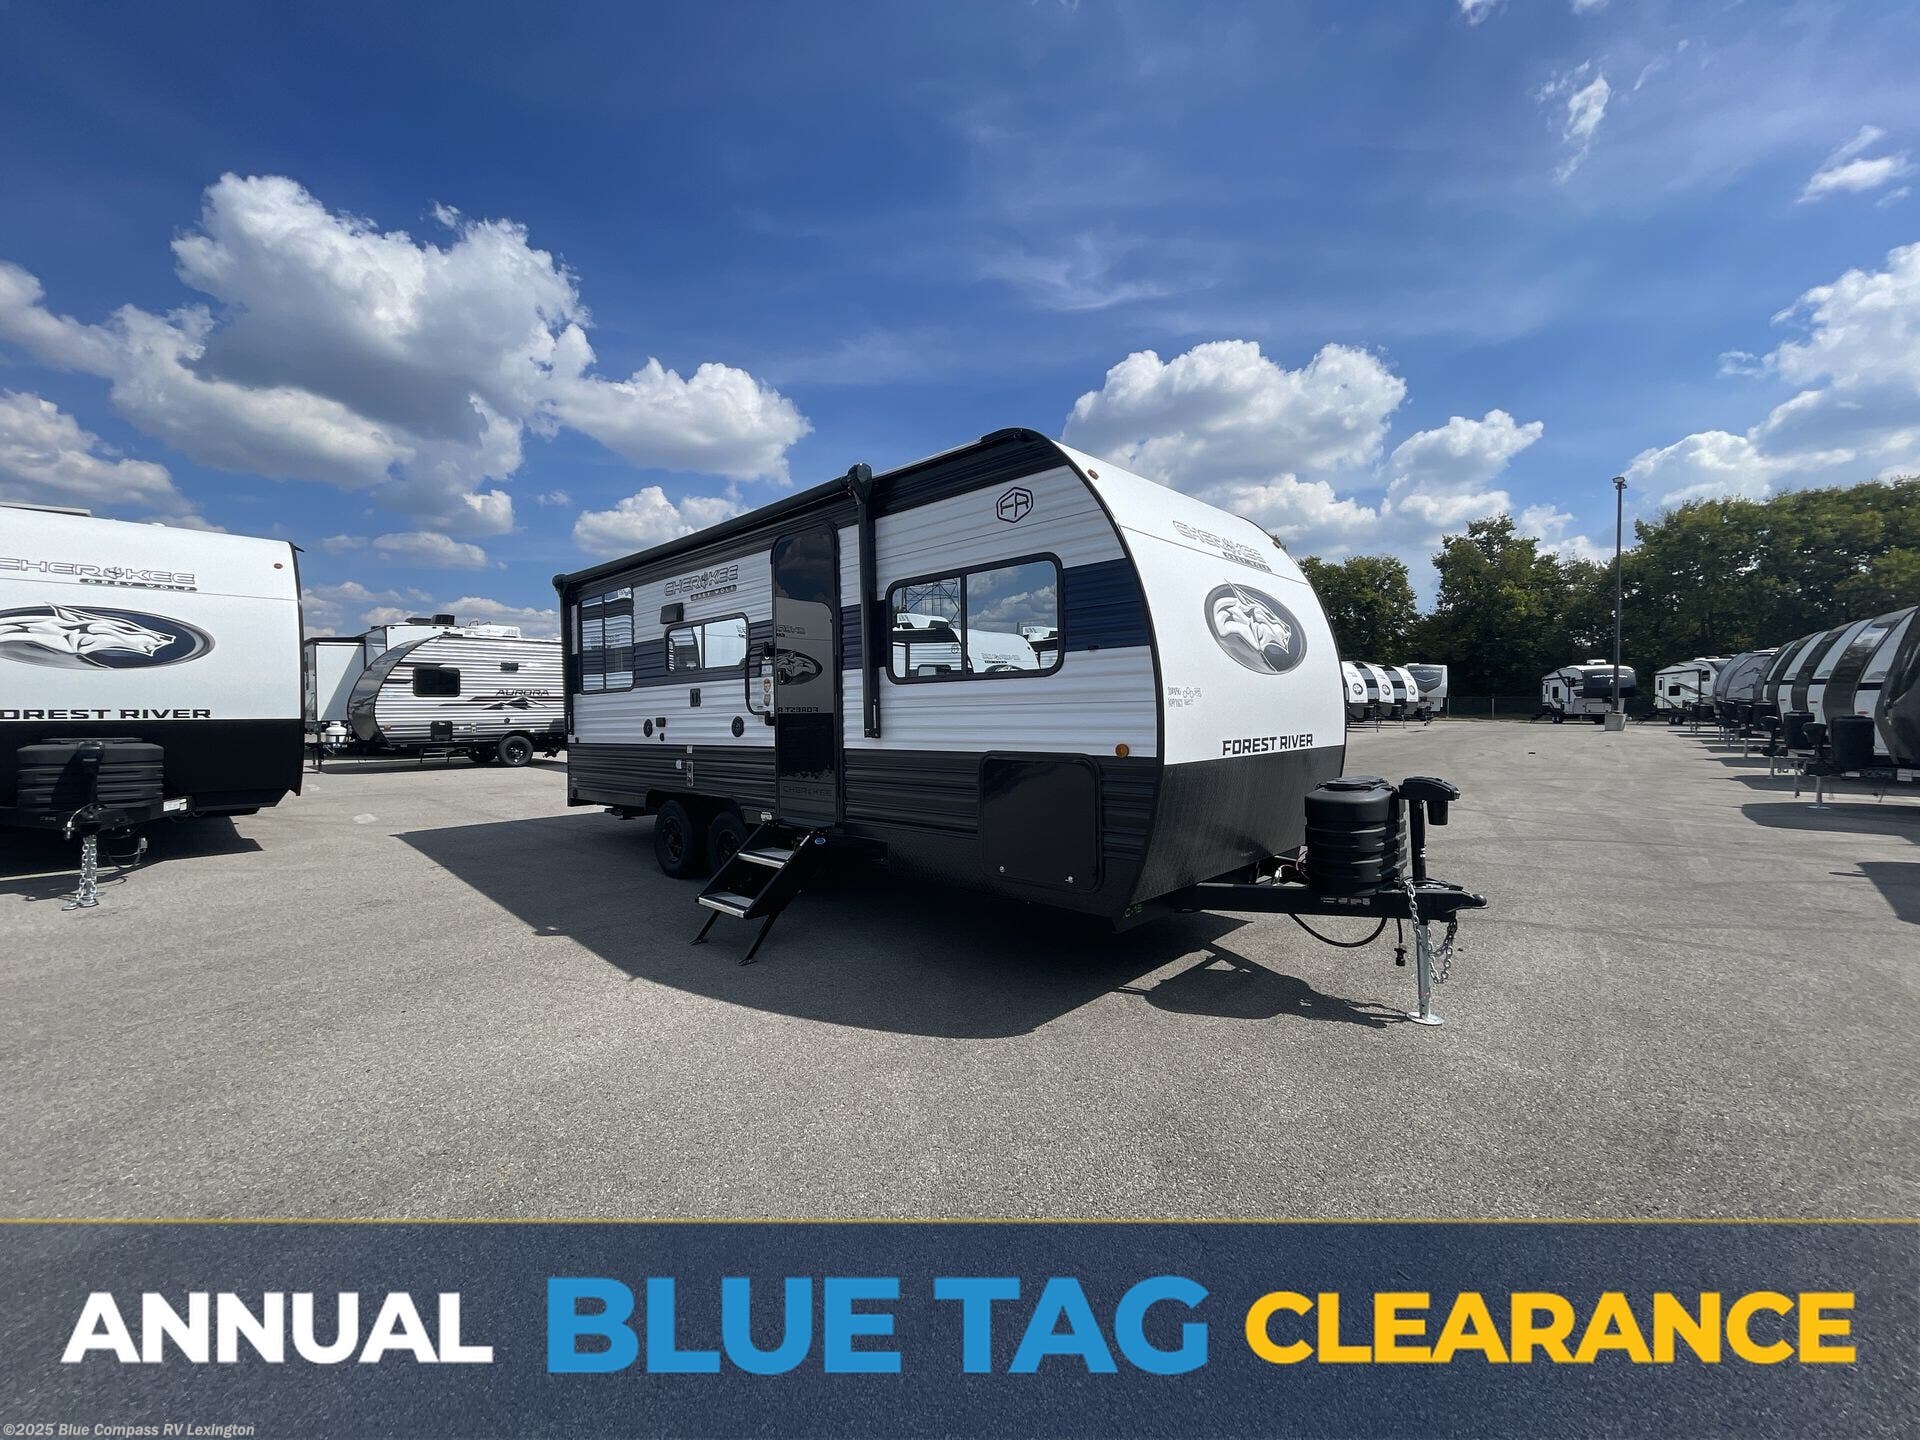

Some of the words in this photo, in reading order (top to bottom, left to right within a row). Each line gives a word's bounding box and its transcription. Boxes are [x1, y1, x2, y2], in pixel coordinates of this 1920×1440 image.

[664, 564, 739, 597] CHEROKEE
[495, 688, 550, 696] AURORA
[119, 709, 211, 719] RIVER
[1222, 736, 1278, 756] FOREST
[1279, 733, 1314, 750] RIVER
